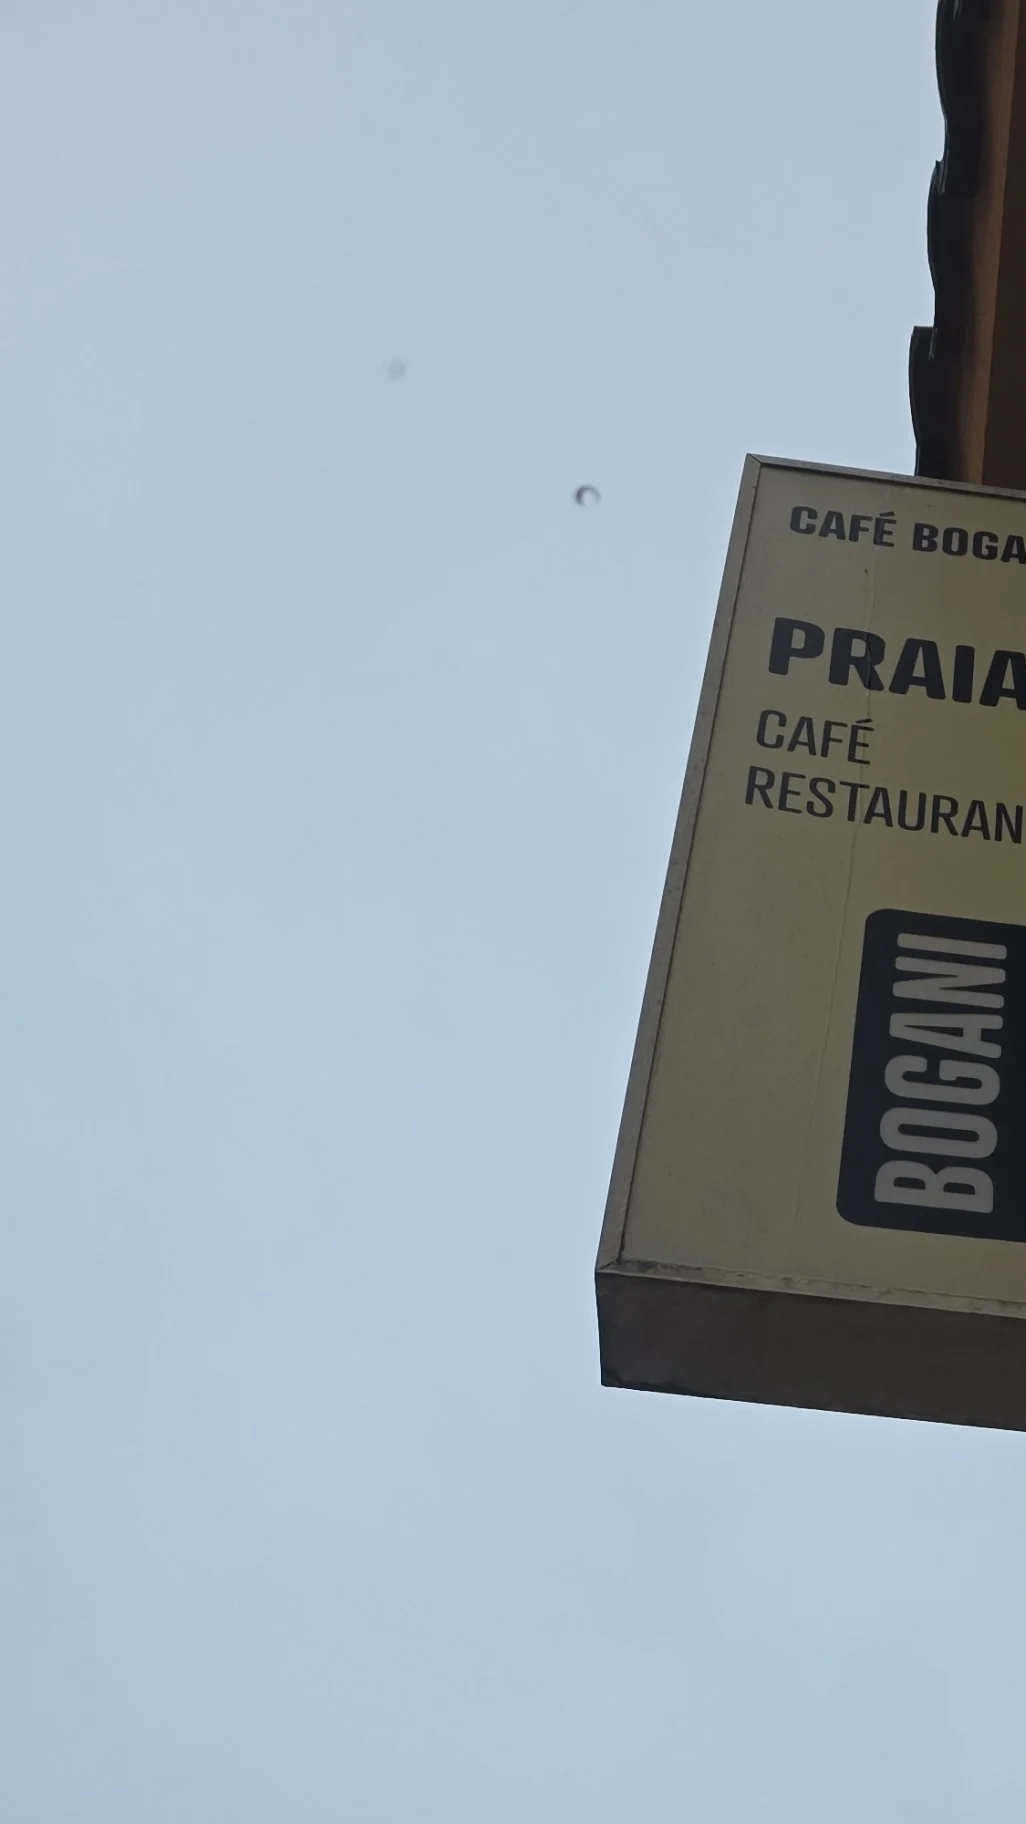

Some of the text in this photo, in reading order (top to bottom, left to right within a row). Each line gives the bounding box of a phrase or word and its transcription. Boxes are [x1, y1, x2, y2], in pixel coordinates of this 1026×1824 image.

[789, 505, 896, 547] CAFÉ
[755, 708, 875, 765] CAFÉ
[874, 933, 1008, 1213] BOGANI
